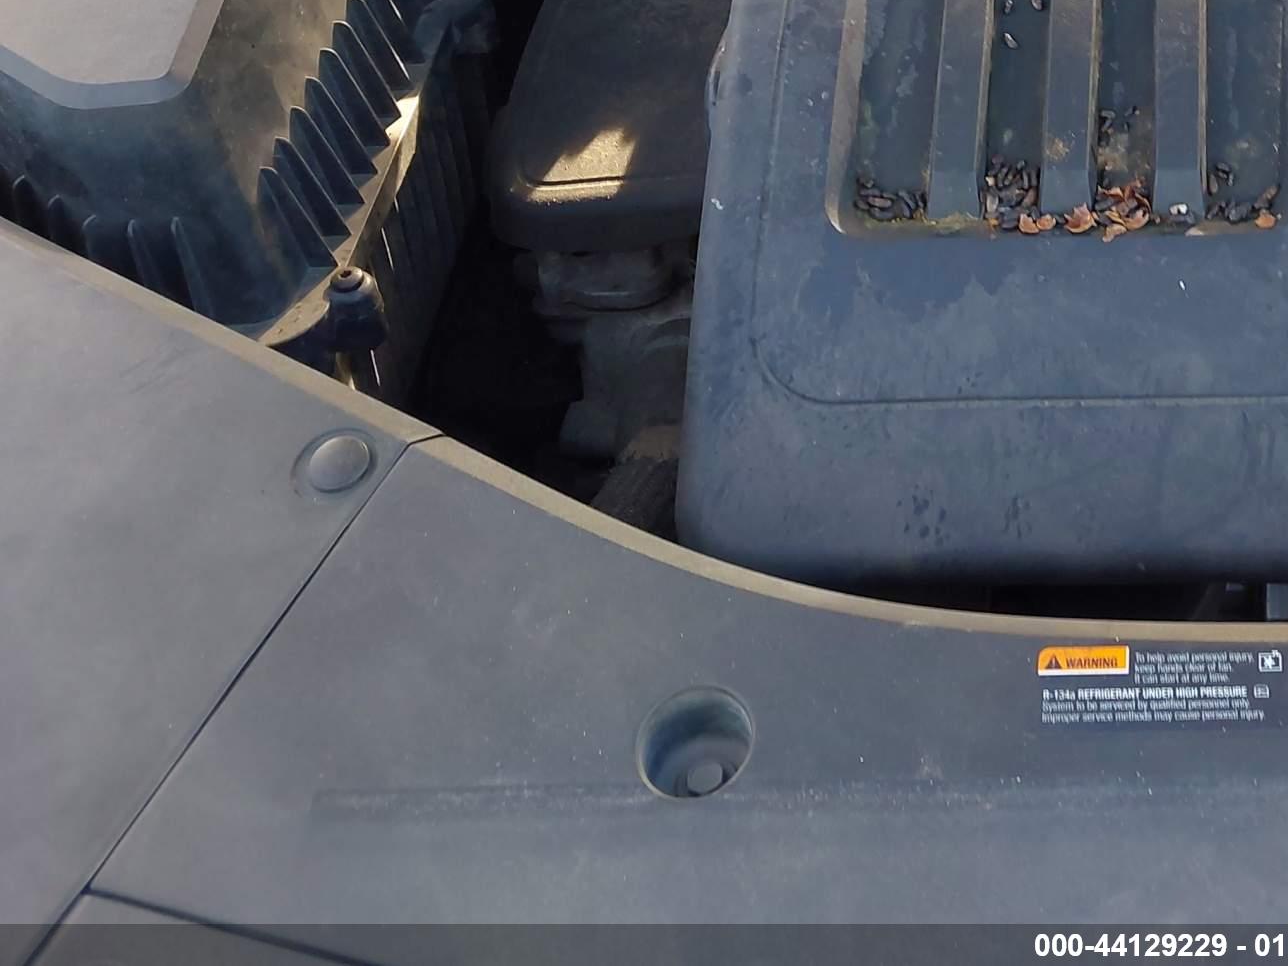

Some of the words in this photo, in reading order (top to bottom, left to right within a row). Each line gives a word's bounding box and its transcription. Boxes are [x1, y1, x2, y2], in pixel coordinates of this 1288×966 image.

[1066, 657, 1118, 669] WARNING
[1078, 687, 1140, 700] REFRIGERANT
[1142, 687, 1174, 699] UNDER
[1176, 686, 1198, 698] HIGH
[1200, 685, 1247, 698] PRESSURE
